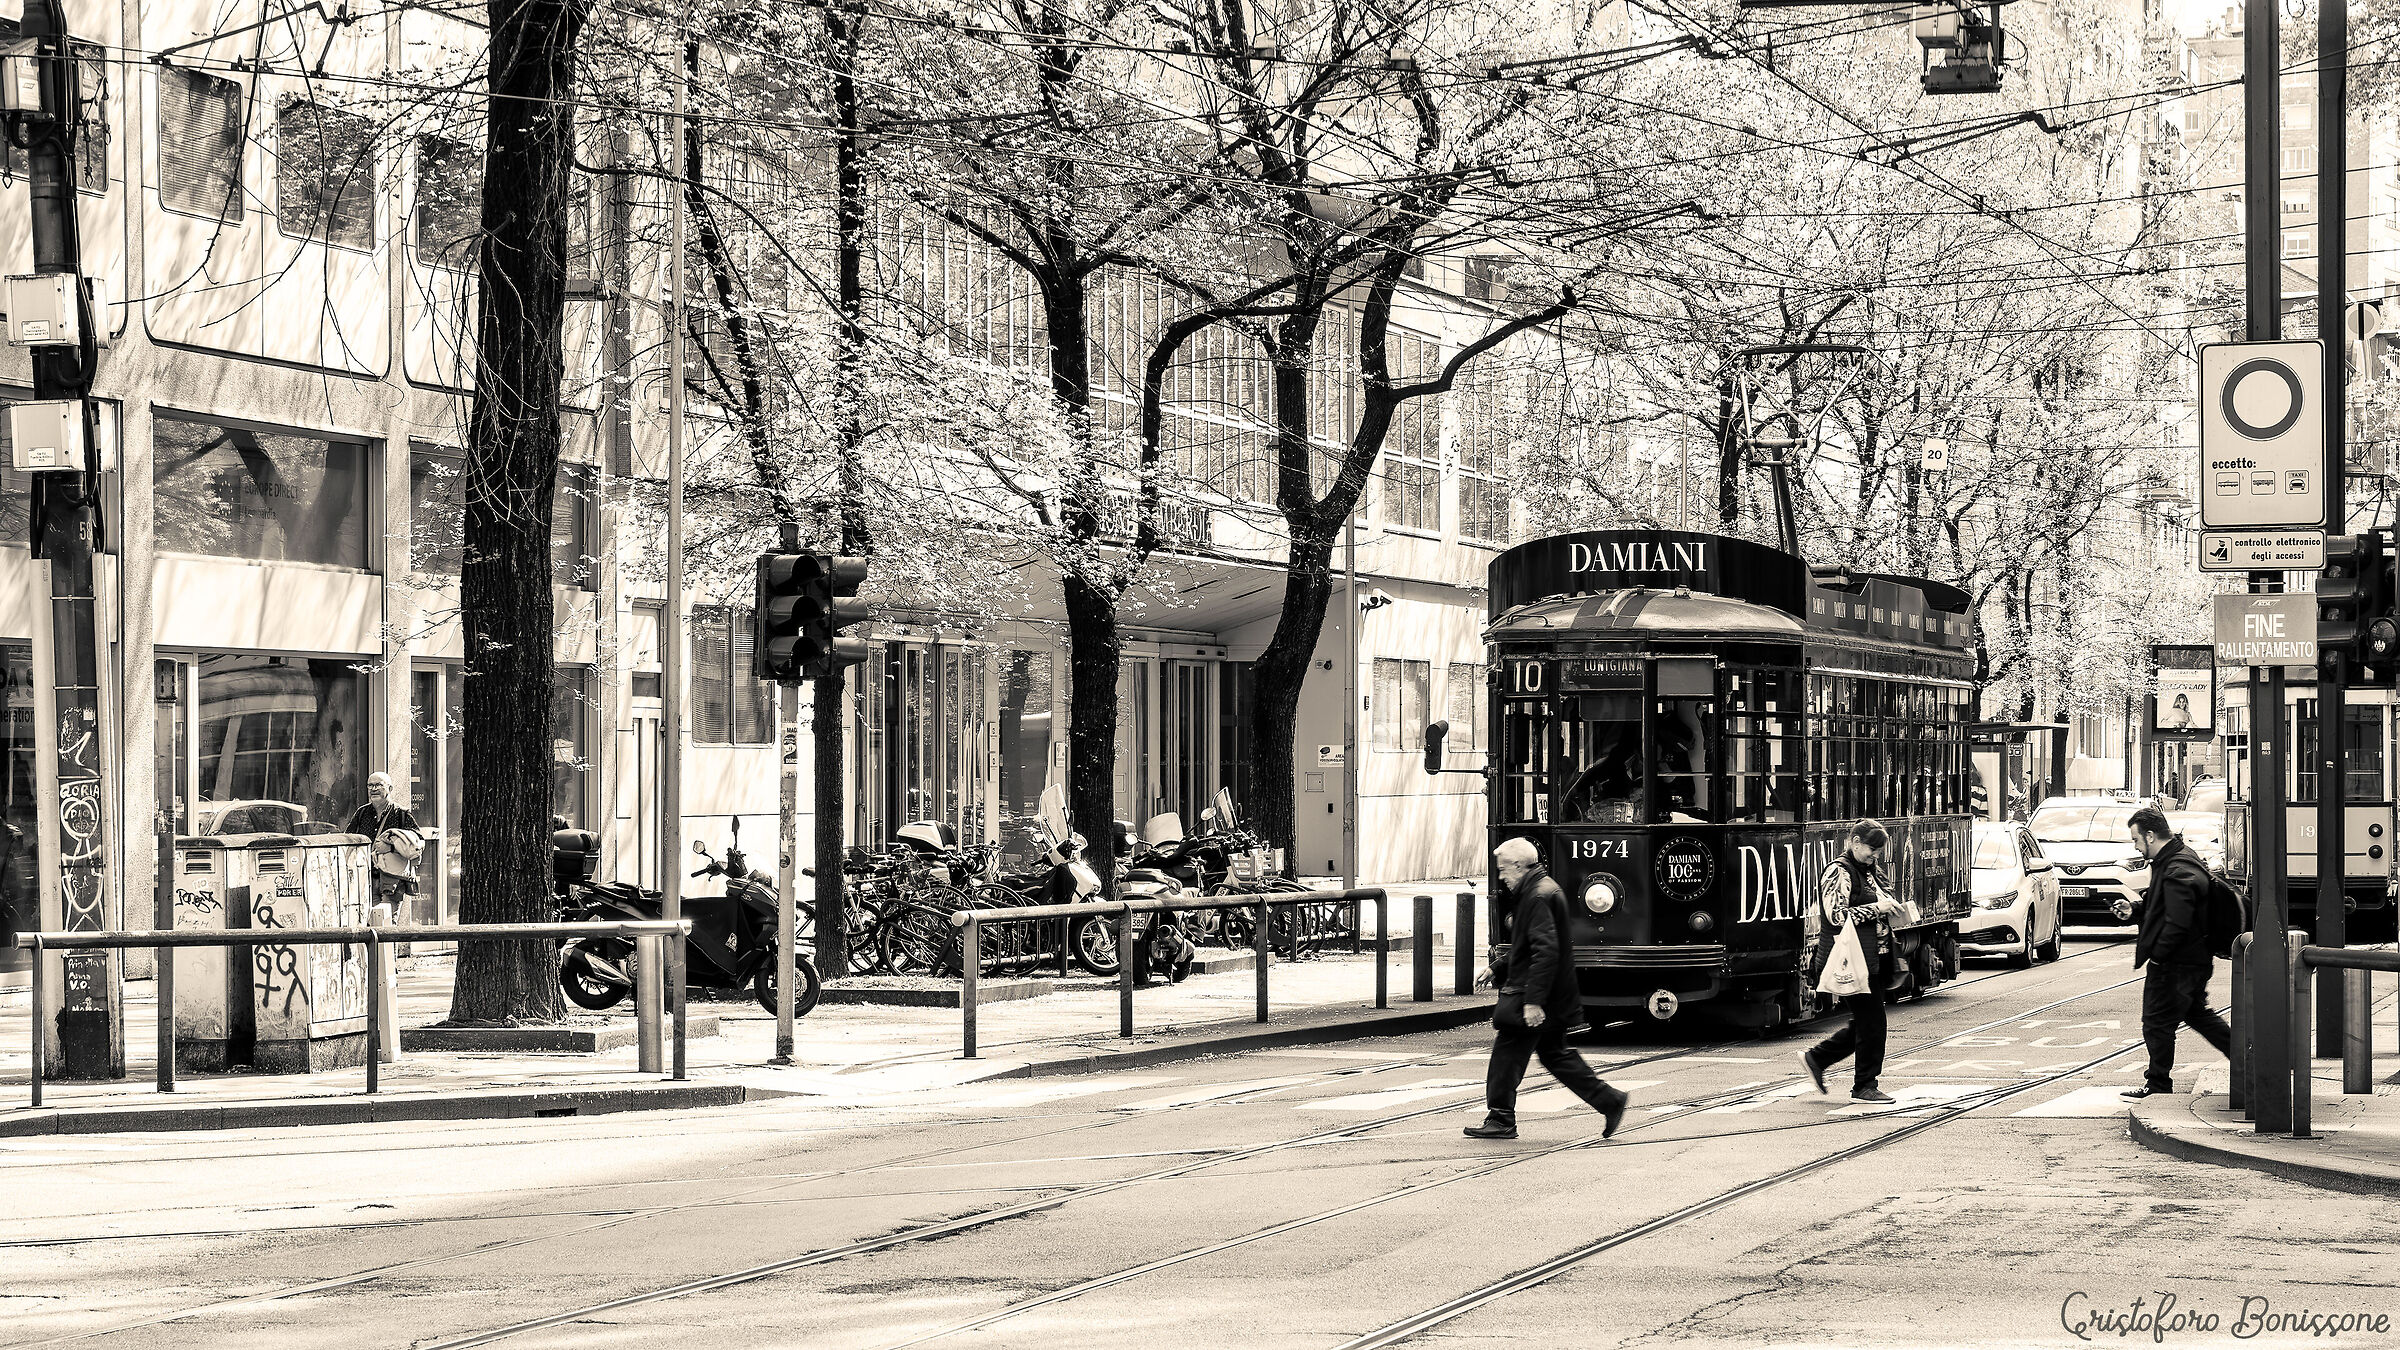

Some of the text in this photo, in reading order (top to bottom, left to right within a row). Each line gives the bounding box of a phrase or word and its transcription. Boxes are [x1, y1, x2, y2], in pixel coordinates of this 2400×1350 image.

[1927, 449, 1943, 460] 20
[2211, 457, 2258, 470] eccetto:
[274, 483, 299, 500] DIRECT
[2234, 537, 2322, 547] controllo elettronico
[1568, 541, 1708, 573] DAMIANI
[2251, 551, 2305, 562] degli accessi
[2243, 612, 2287, 639] FINE
[2218, 640, 2315, 659] RALLENTAMENTO
[1514, 660, 1543, 693] 10
[2299, 825, 2317, 838] 19
[1571, 839, 1629, 859] 1974
[1668, 854, 1701, 864] DAMIANI
